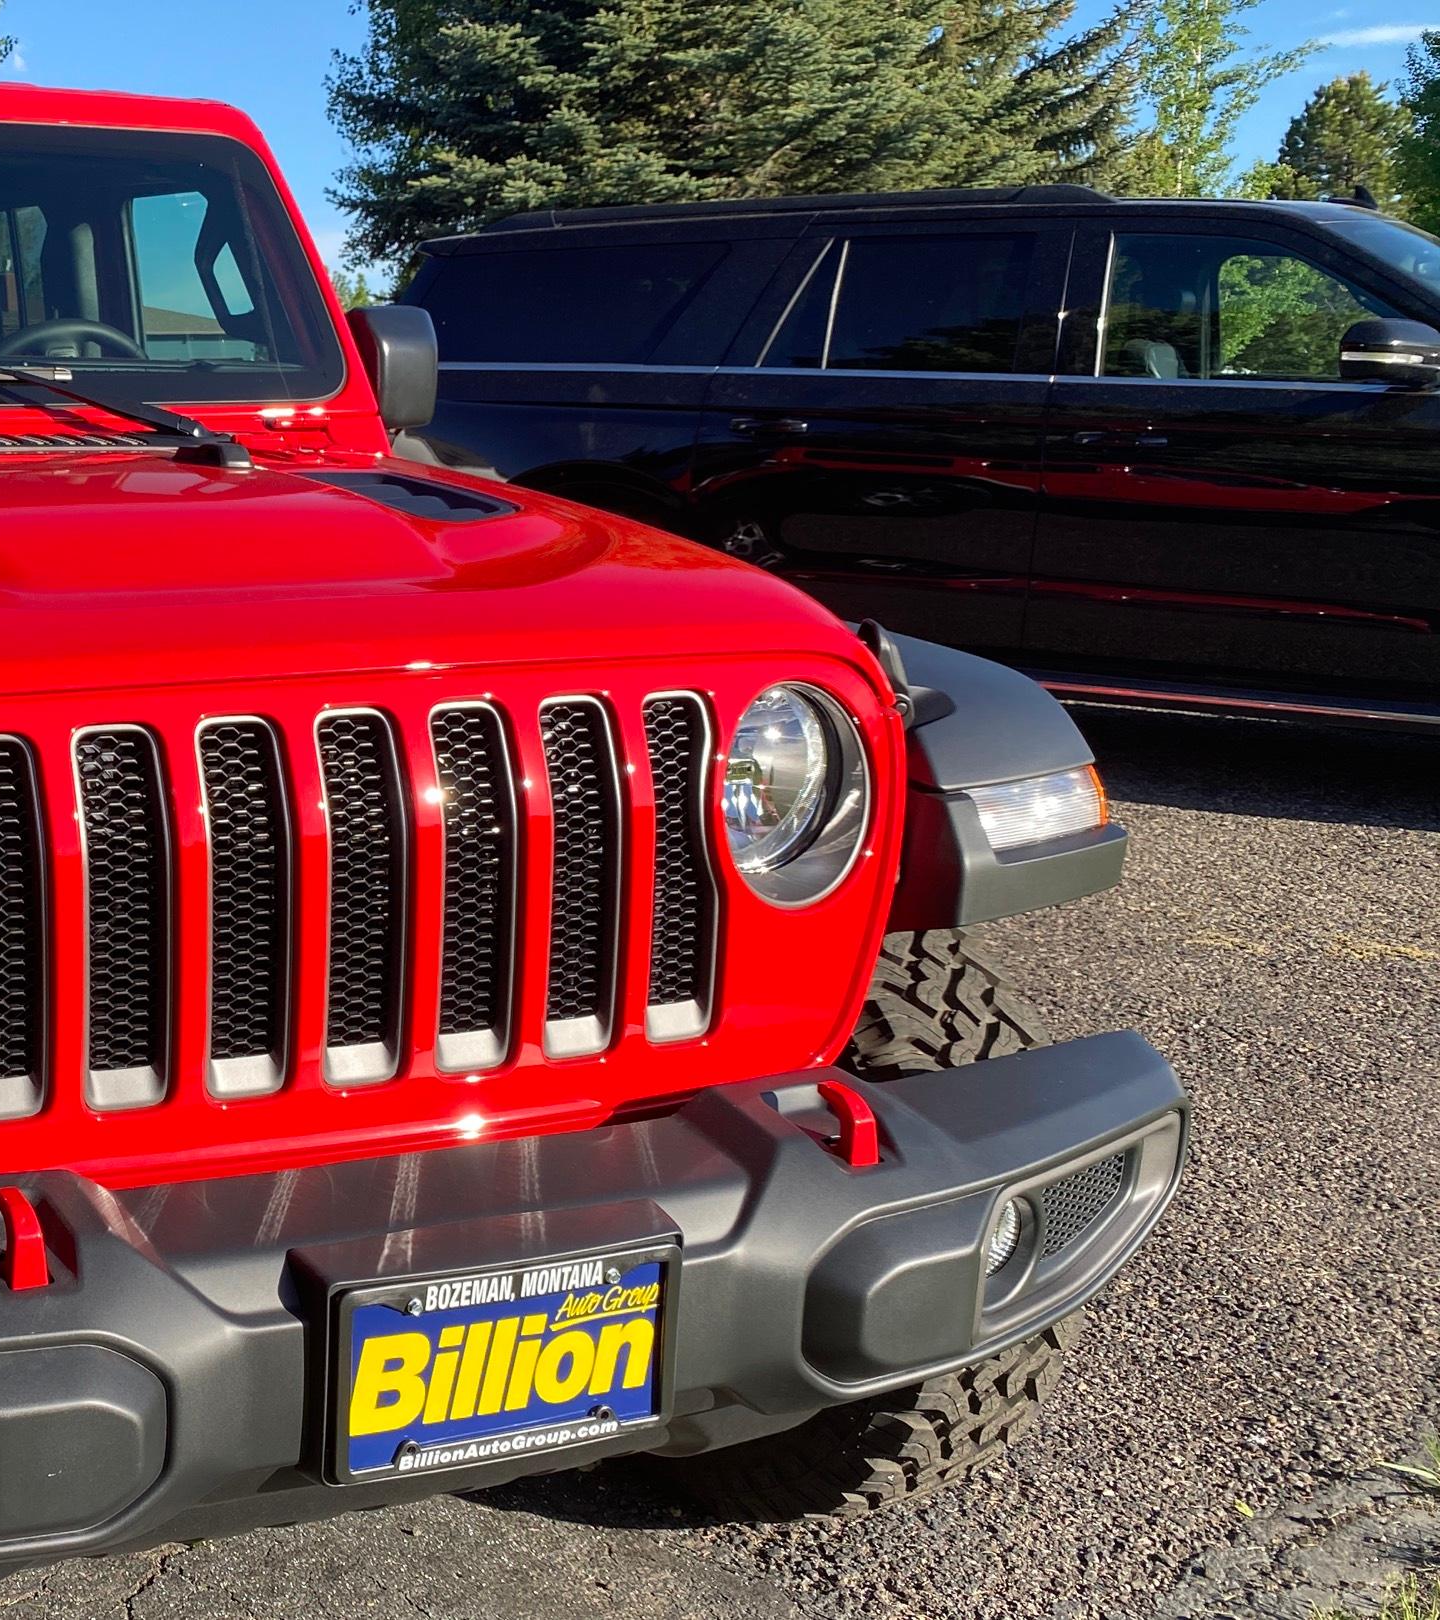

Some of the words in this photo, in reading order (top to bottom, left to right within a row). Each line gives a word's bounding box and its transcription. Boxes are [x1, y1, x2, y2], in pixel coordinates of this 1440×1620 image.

[425, 1275, 516, 1312] BOZEMAN,
[520, 1260, 604, 1298] MONTANA
[555, 1290, 602, 1321] Auto
[602, 1282, 659, 1314] Group
[349, 1313, 655, 1437] Billion
[398, 1420, 619, 1472] BillionAutoGroup.com
